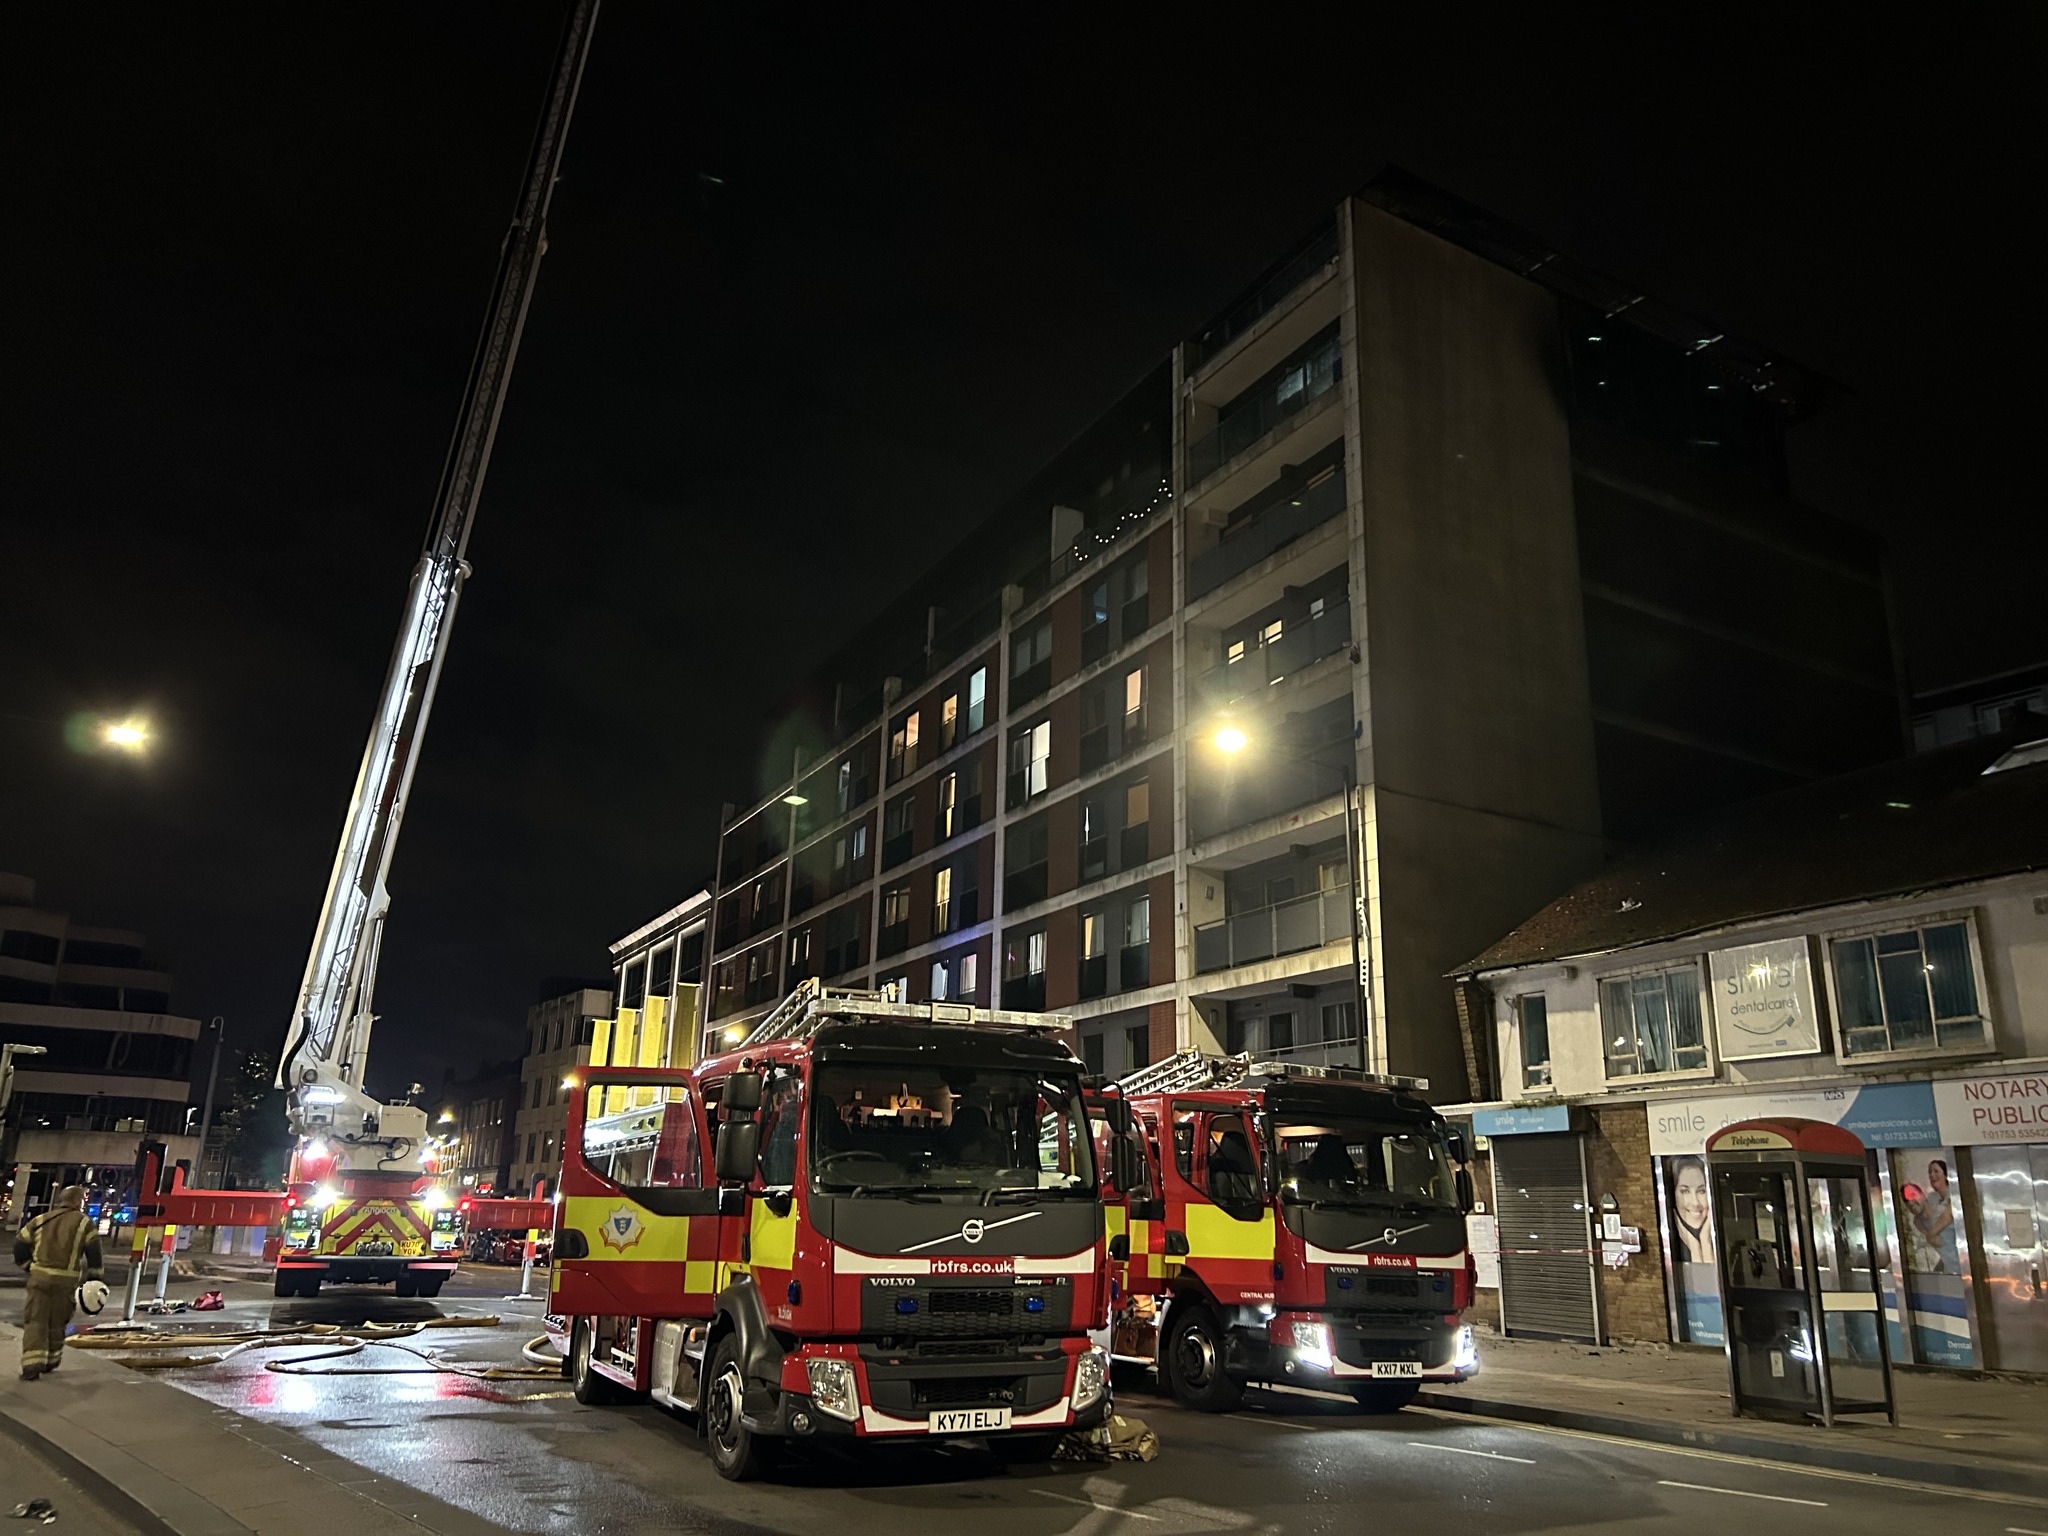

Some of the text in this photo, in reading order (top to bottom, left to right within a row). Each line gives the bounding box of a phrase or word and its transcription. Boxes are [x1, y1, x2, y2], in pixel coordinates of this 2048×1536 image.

[1730, 996, 1795, 1015] dentalcare
[1963, 1078, 2048, 1101] NOTARY
[1494, 1112, 1514, 1126] smile
[1658, 1105, 1705, 1133] smile
[1972, 1104, 2048, 1126] PUBLIC
[1731, 1135, 1770, 1147] Telephone
[931, 1260, 1013, 1274] rbfrs.co.uk
[1374, 1256, 1412, 1267] rbfrs.co.uk
[1330, 1266, 1359, 1274] VOLVO
[870, 1277, 915, 1287] VOLVO
[1240, 1291, 1263, 1299] CENTRAL
[1947, 1340, 1973, 1350] Dental
[1377, 1363, 1398, 1375] KX17
[937, 1410, 1003, 1431] KY71 ELJ
